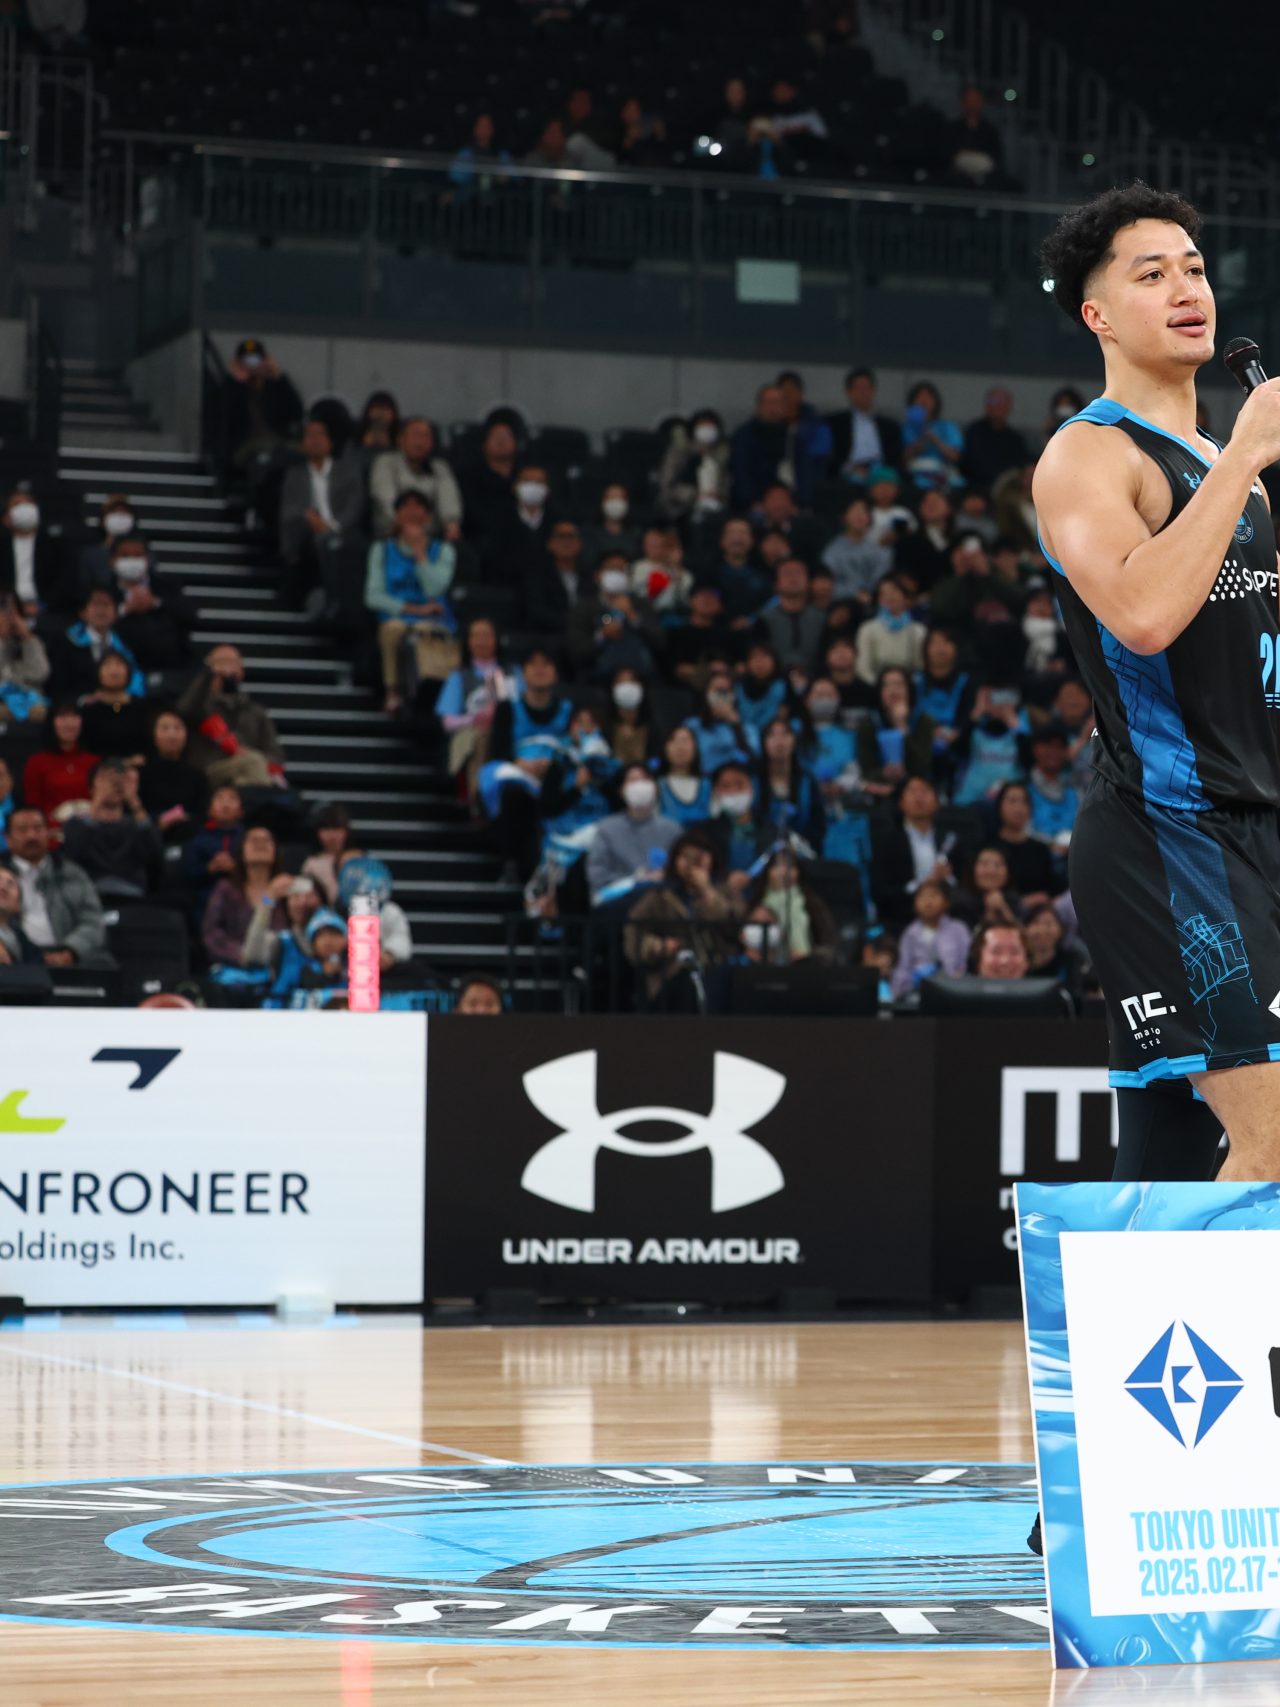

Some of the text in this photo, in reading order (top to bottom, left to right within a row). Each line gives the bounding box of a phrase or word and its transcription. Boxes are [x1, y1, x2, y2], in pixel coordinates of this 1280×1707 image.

[0, 1171, 309, 1215] NFRONEER
[0, 1231, 184, 1268] oldings Inc.
[502, 1238, 801, 1264] UNDER ARMOUR
[0, 1467, 1041, 1520] OKYO UNI
[1129, 1509, 1215, 1552] TOKYO
